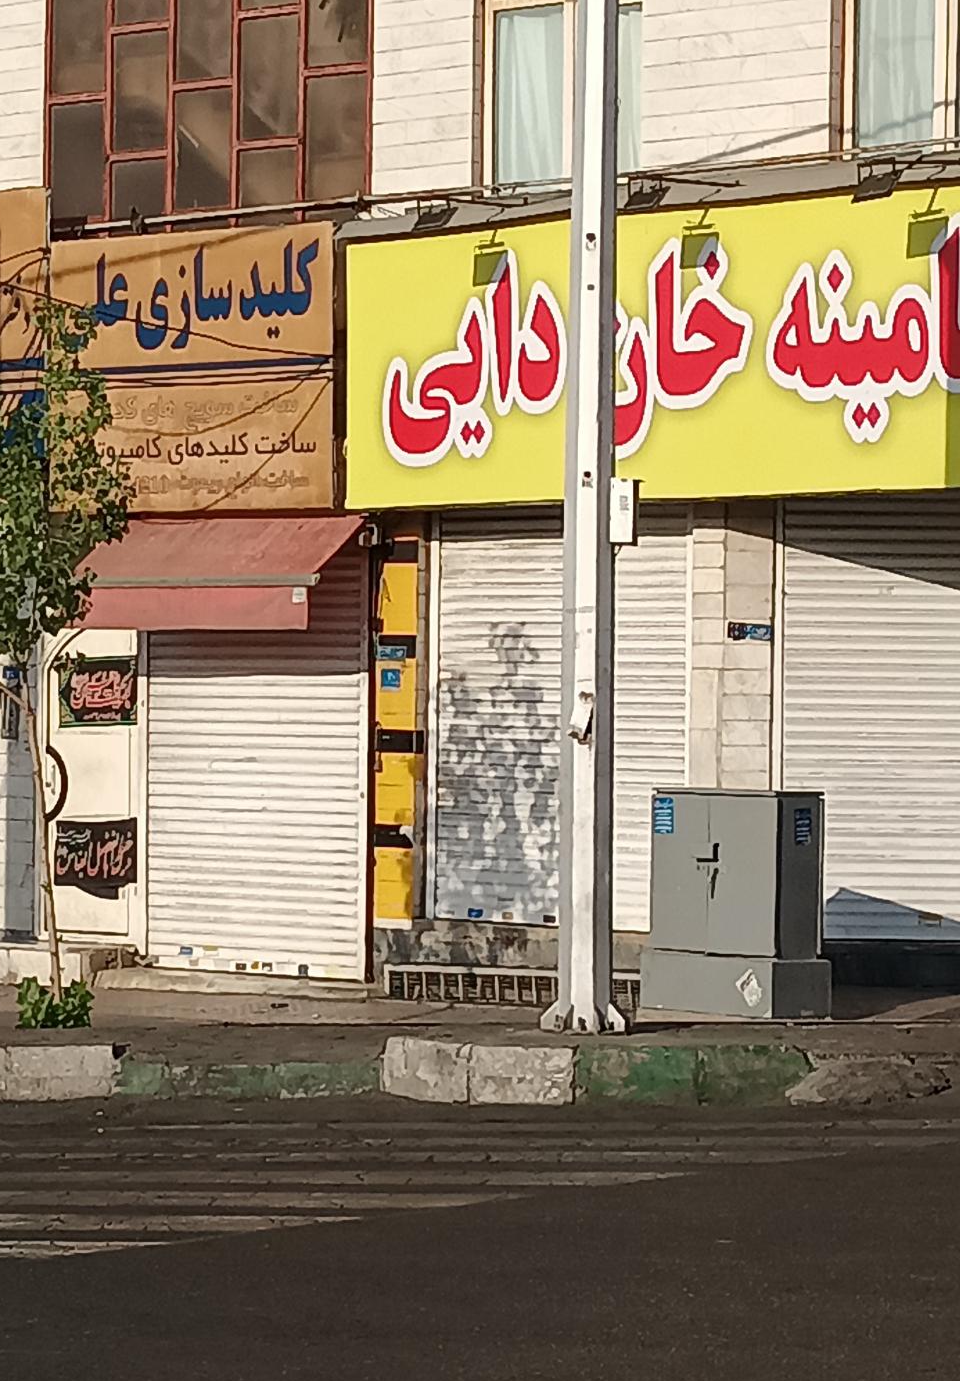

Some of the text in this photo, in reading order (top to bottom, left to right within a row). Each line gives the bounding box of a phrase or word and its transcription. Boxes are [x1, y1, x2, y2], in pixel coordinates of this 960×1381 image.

[388, 256, 562, 455] دایی
[773, 223, 960, 428] امینه
[253, 431, 318, 455] ساخت
